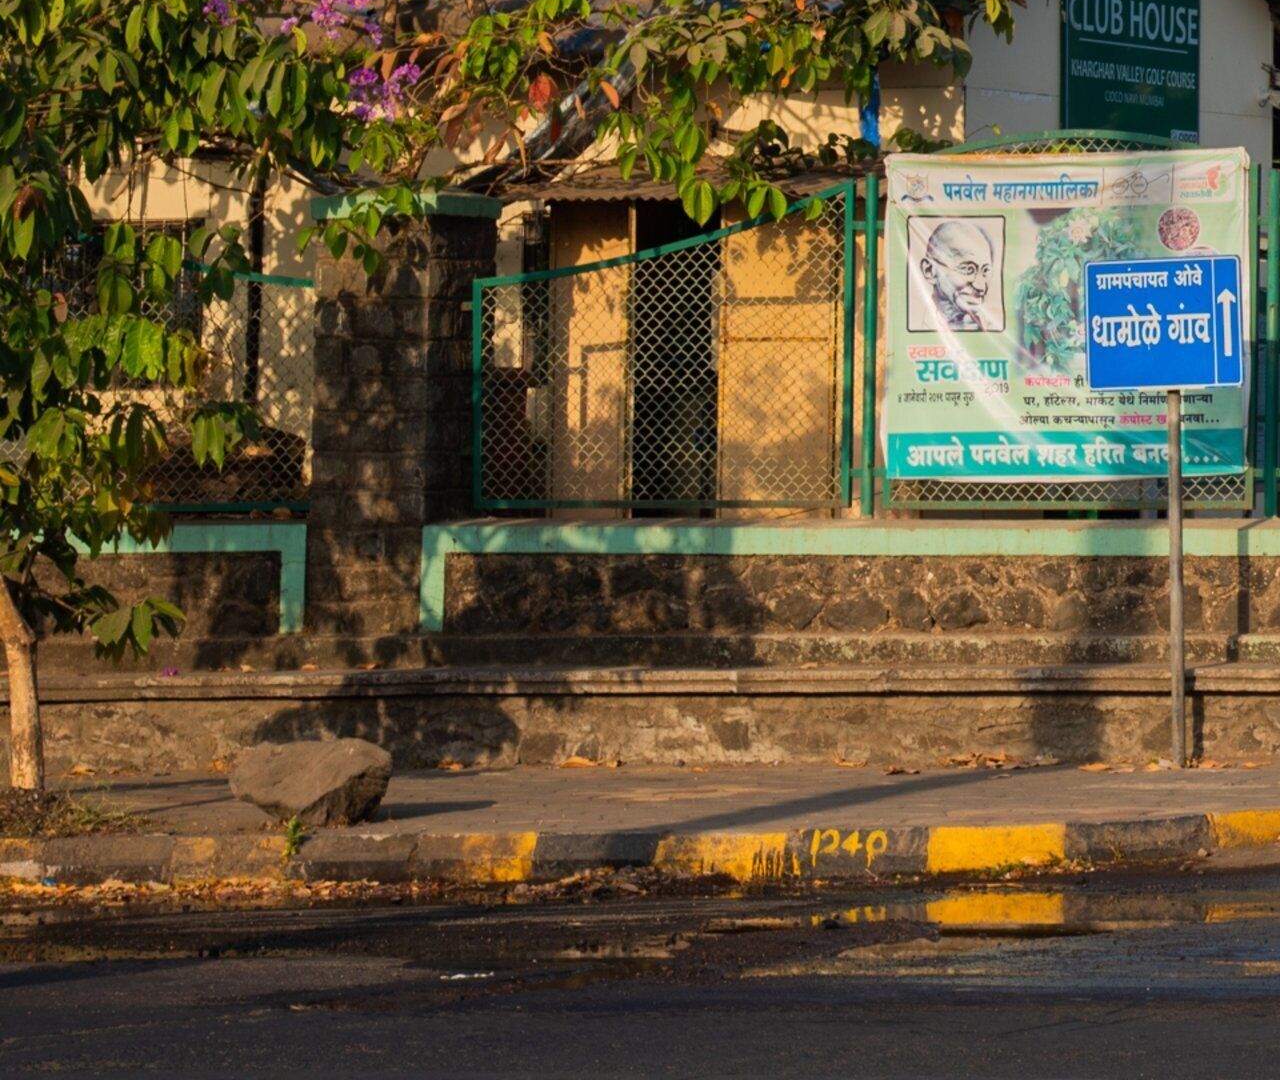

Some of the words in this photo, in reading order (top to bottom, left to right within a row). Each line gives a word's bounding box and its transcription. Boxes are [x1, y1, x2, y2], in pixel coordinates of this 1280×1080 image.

[1129, 0, 1198, 46] HOUSE
[1071, 58, 1115, 80] KHARGHAR
[1116, 63, 1145, 83] VALLEY
[1145, 67, 1165, 86] GOLF
[1166, 70, 1196, 89] COURSE
[943, 174, 987, 201] पनवेल
[993, 173, 1099, 203] महानगरपालिका
[1095, 267, 1168, 291] ग्रामपंचायत
[1173, 264, 1203, 287] ओवे
[1092, 303, 1162, 348] धामोळे
[1166, 302, 1211, 344] गांव
[984, 382, 1010, 394] 2019
[1074, 374, 1084, 388] ही
[1024, 395, 1040, 408] घर,
[906, 435, 965, 467] आपले
[969, 434, 1030, 466] पनवेल
[1036, 442, 1077, 467] शहर
[1082, 434, 1126, 468] हरित
